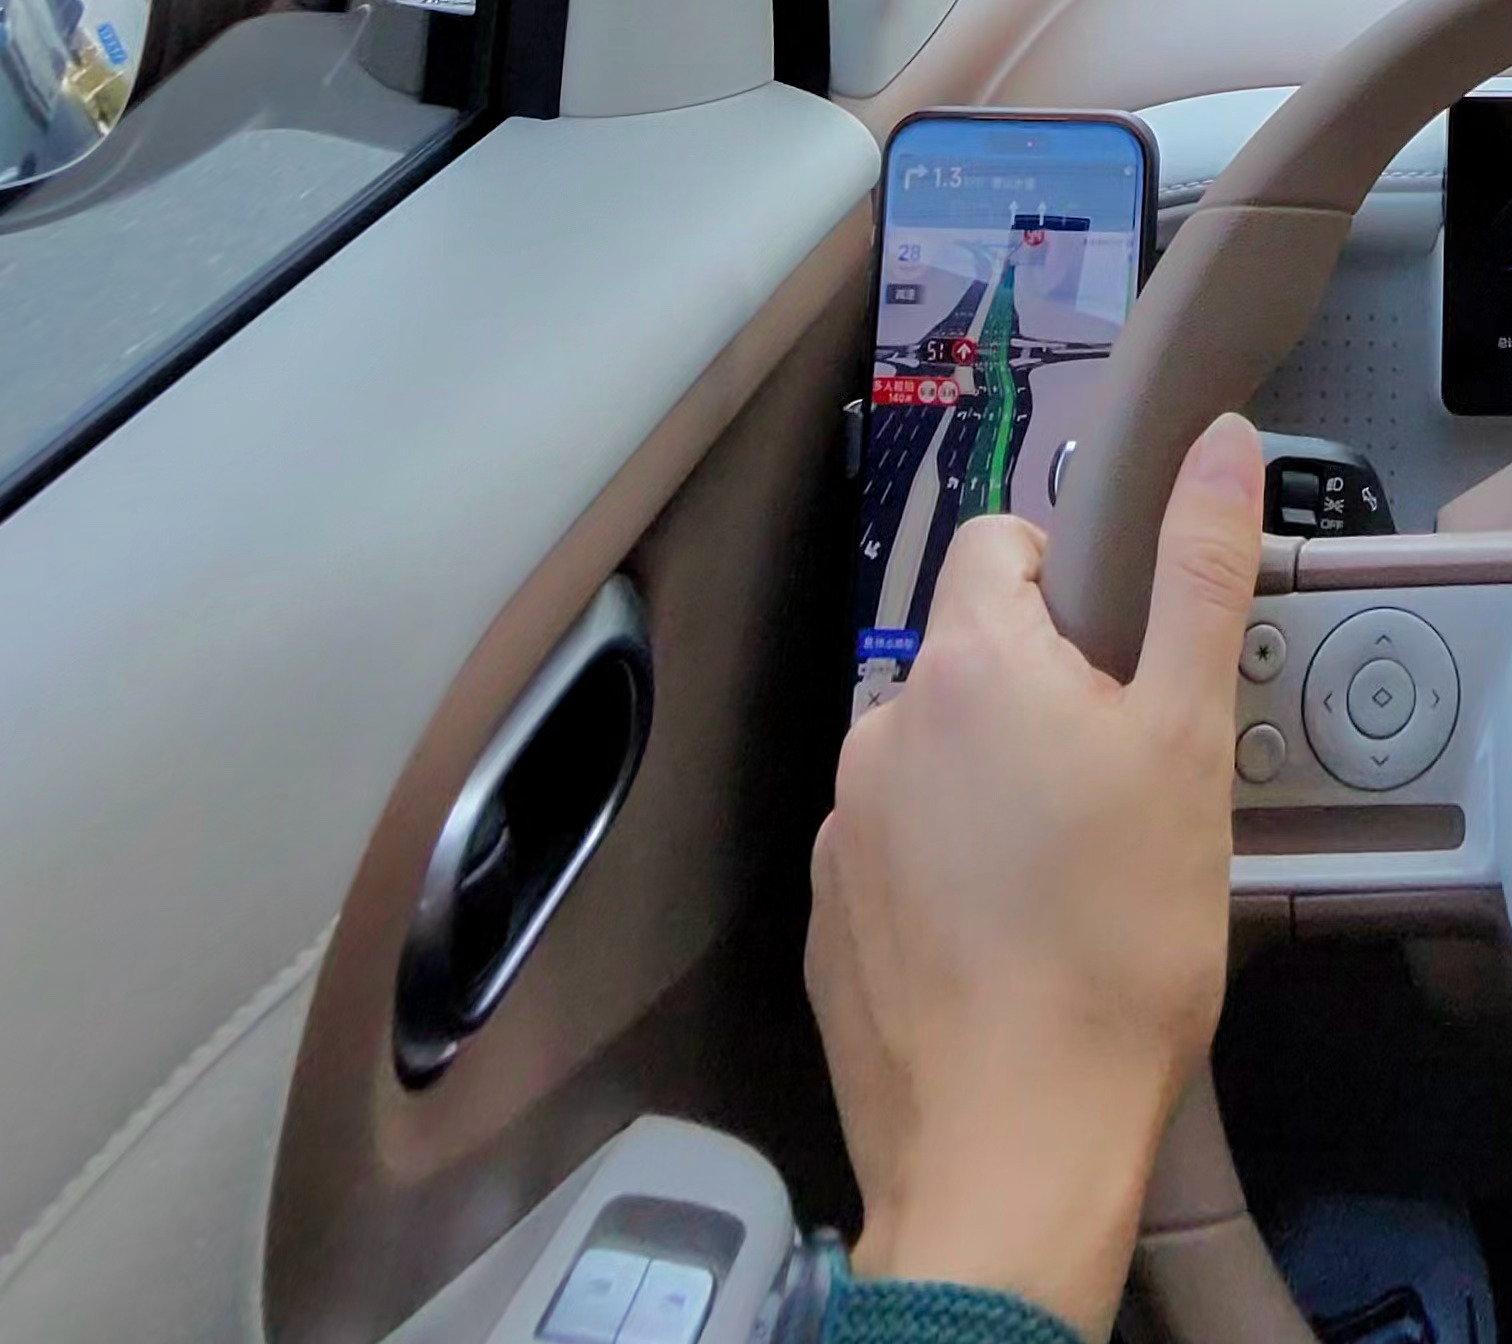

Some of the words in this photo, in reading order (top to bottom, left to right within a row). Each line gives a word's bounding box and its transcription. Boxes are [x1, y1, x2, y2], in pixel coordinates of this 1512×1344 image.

[933, 167, 962, 188] 1.3
[897, 244, 922, 262] 28
[927, 340, 944, 361] 51
[1320, 518, 1345, 530] OFF
